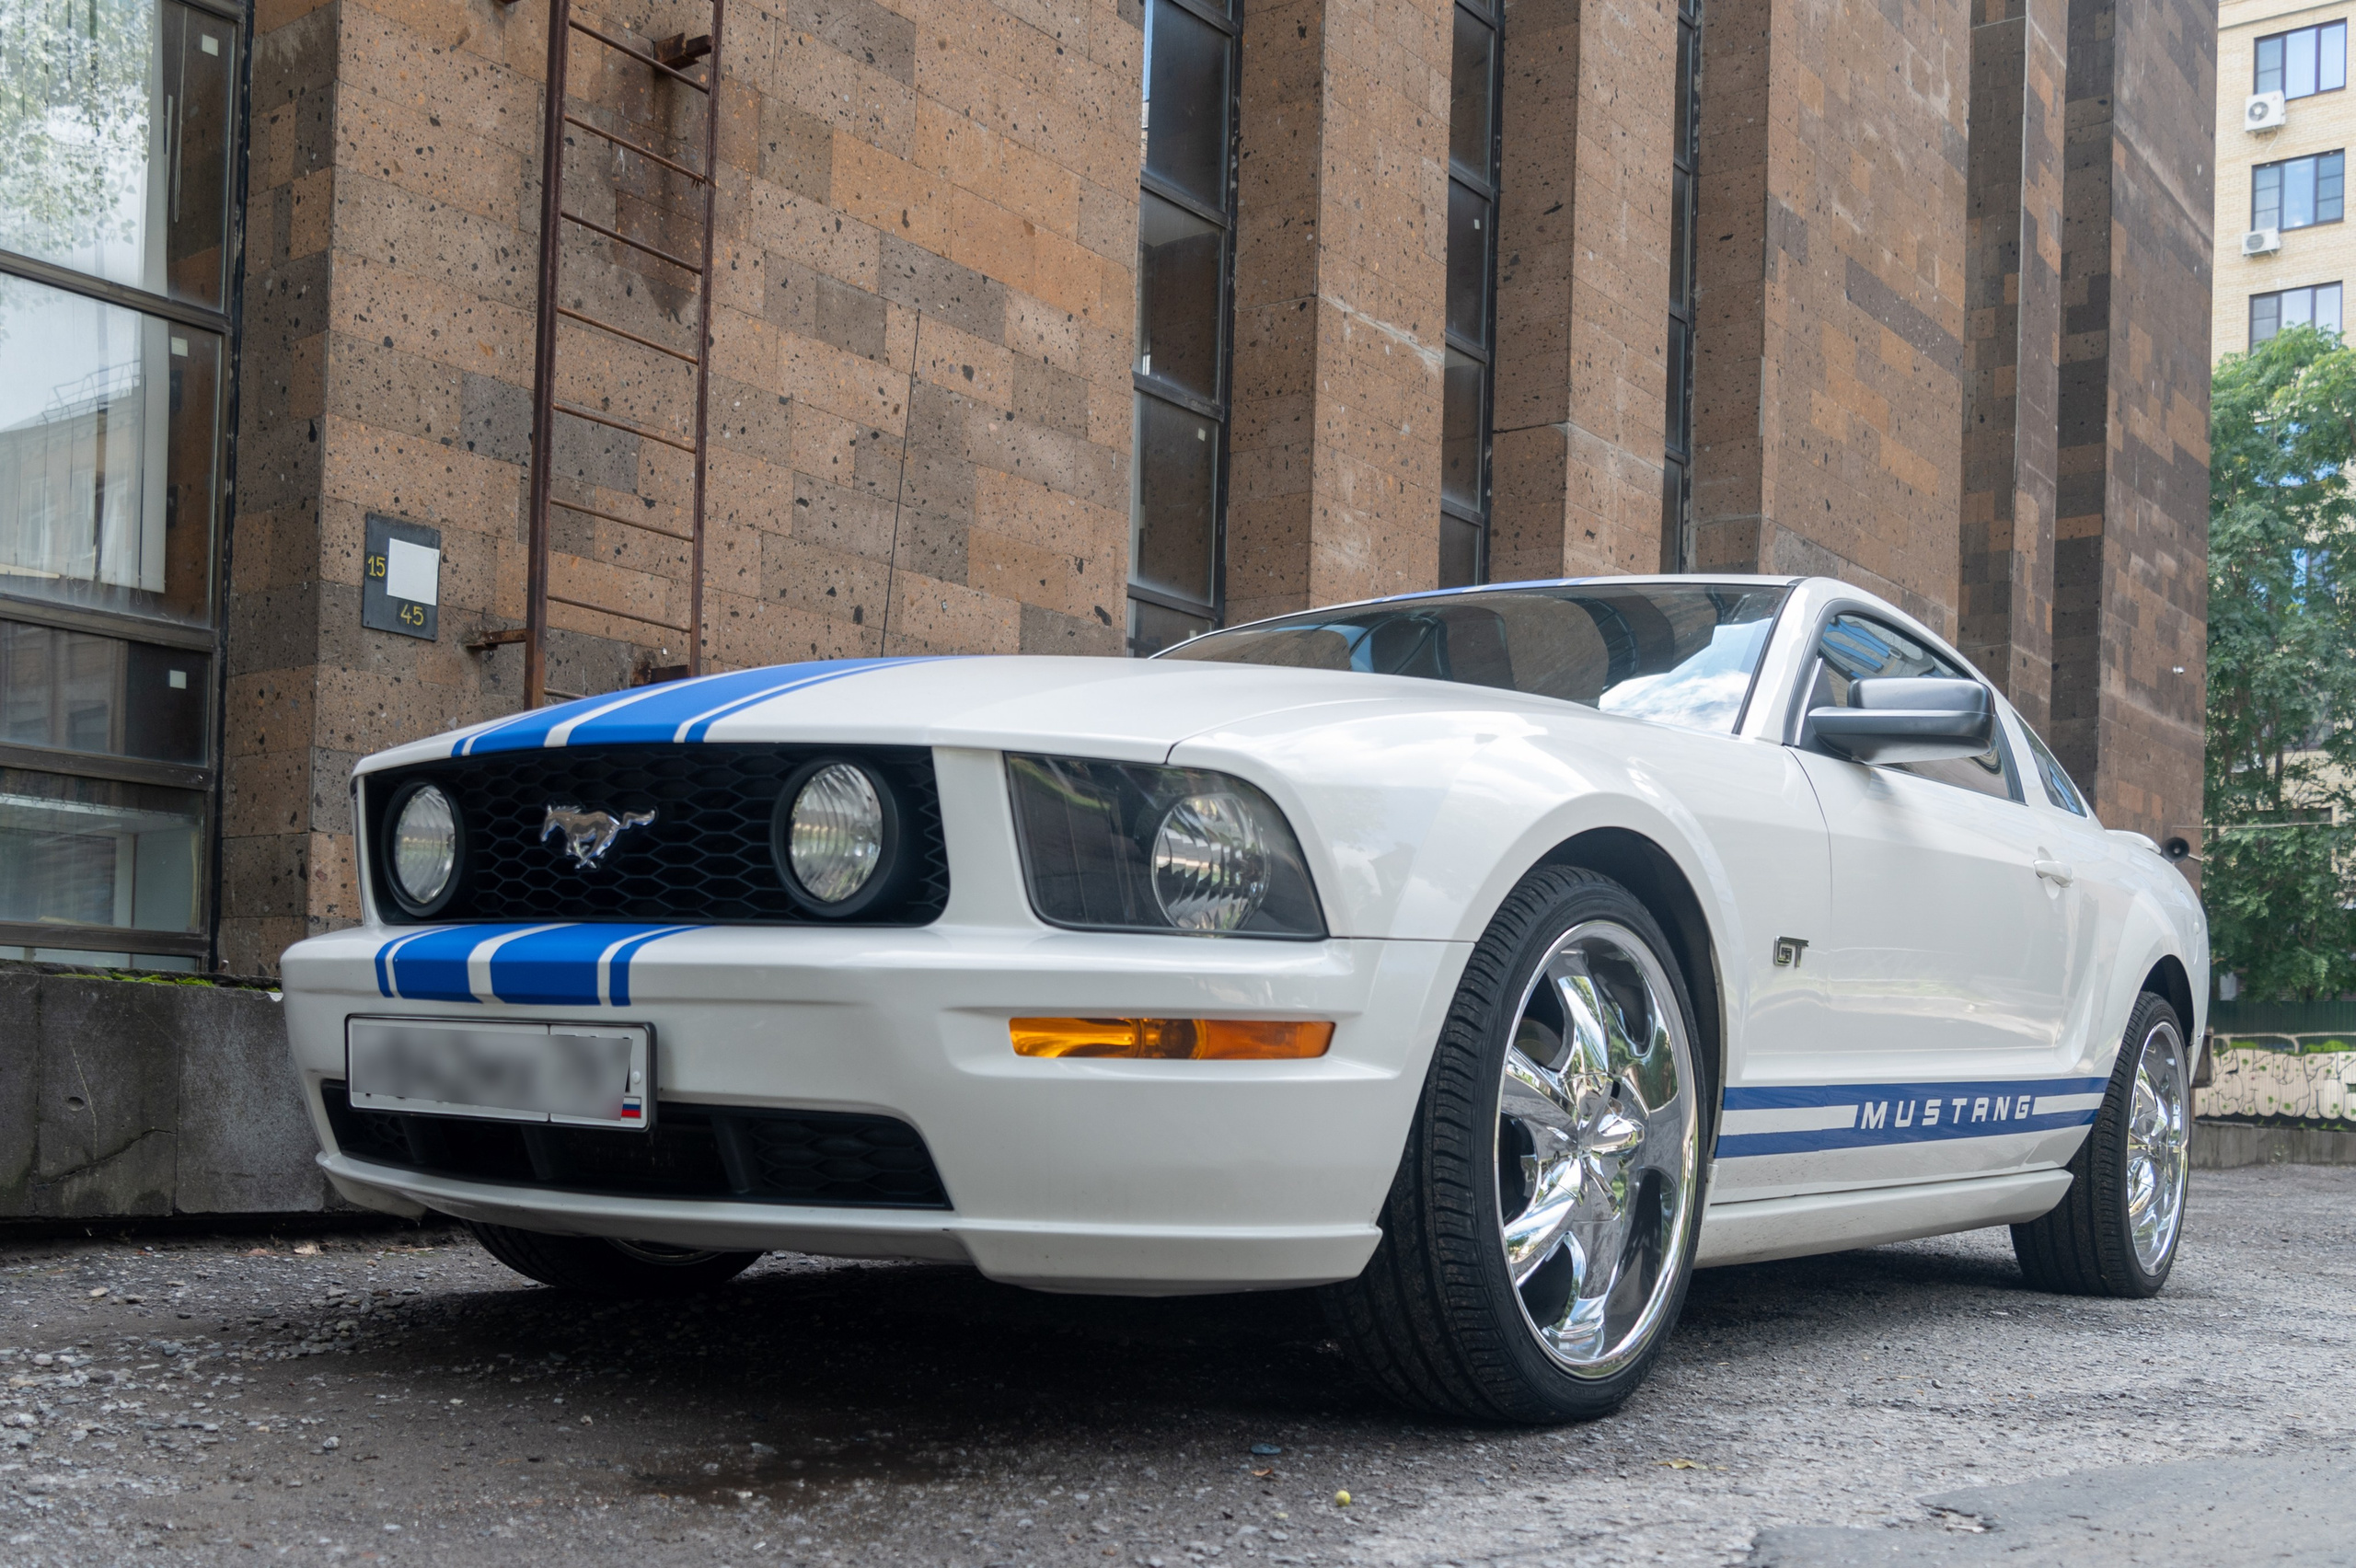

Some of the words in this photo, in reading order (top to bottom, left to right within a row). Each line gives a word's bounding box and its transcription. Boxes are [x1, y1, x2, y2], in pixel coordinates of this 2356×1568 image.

[368, 555, 386, 578] 15
[400, 604, 424, 627] 45
[1773, 935, 1809, 969] GT
[1860, 1095, 2031, 1130] MUSTANG
